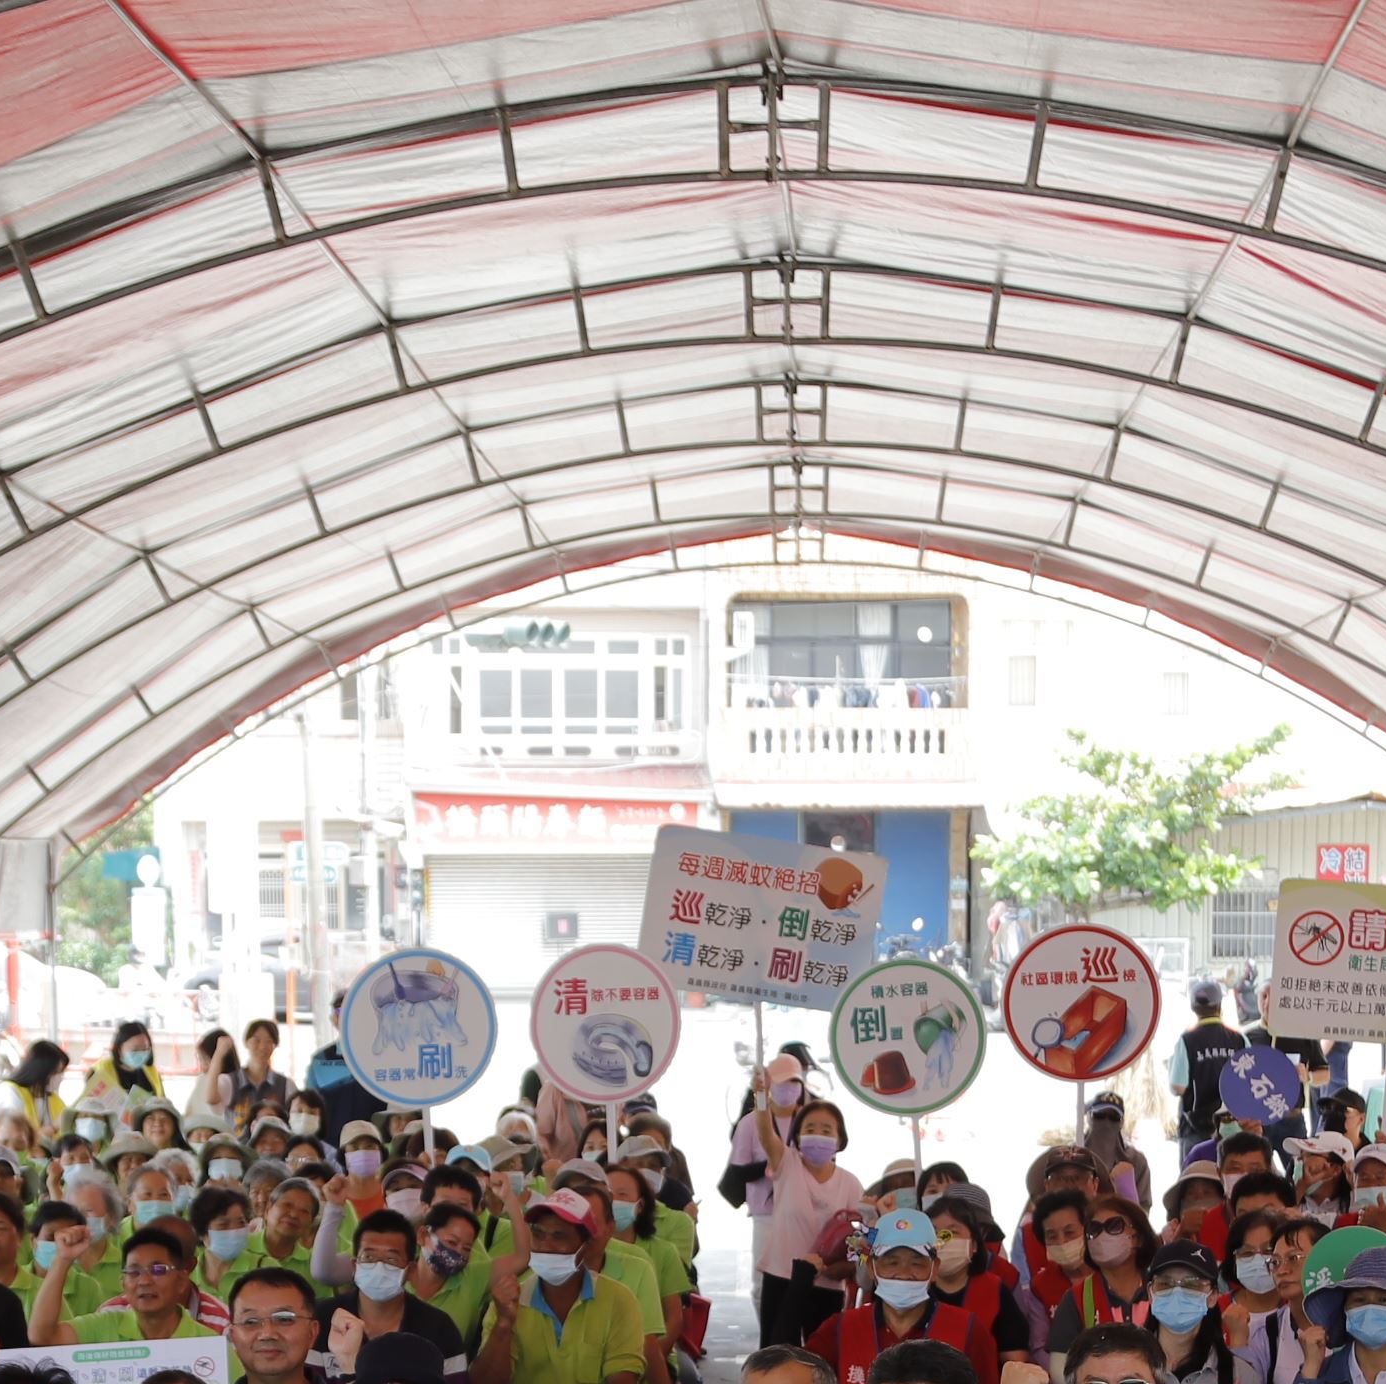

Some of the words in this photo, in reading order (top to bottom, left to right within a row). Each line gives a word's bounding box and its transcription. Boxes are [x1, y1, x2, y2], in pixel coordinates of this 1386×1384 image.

[677, 851, 821, 896] 每週滅蚊絕招
[1230, 1052, 1291, 1121] 東石鄉
